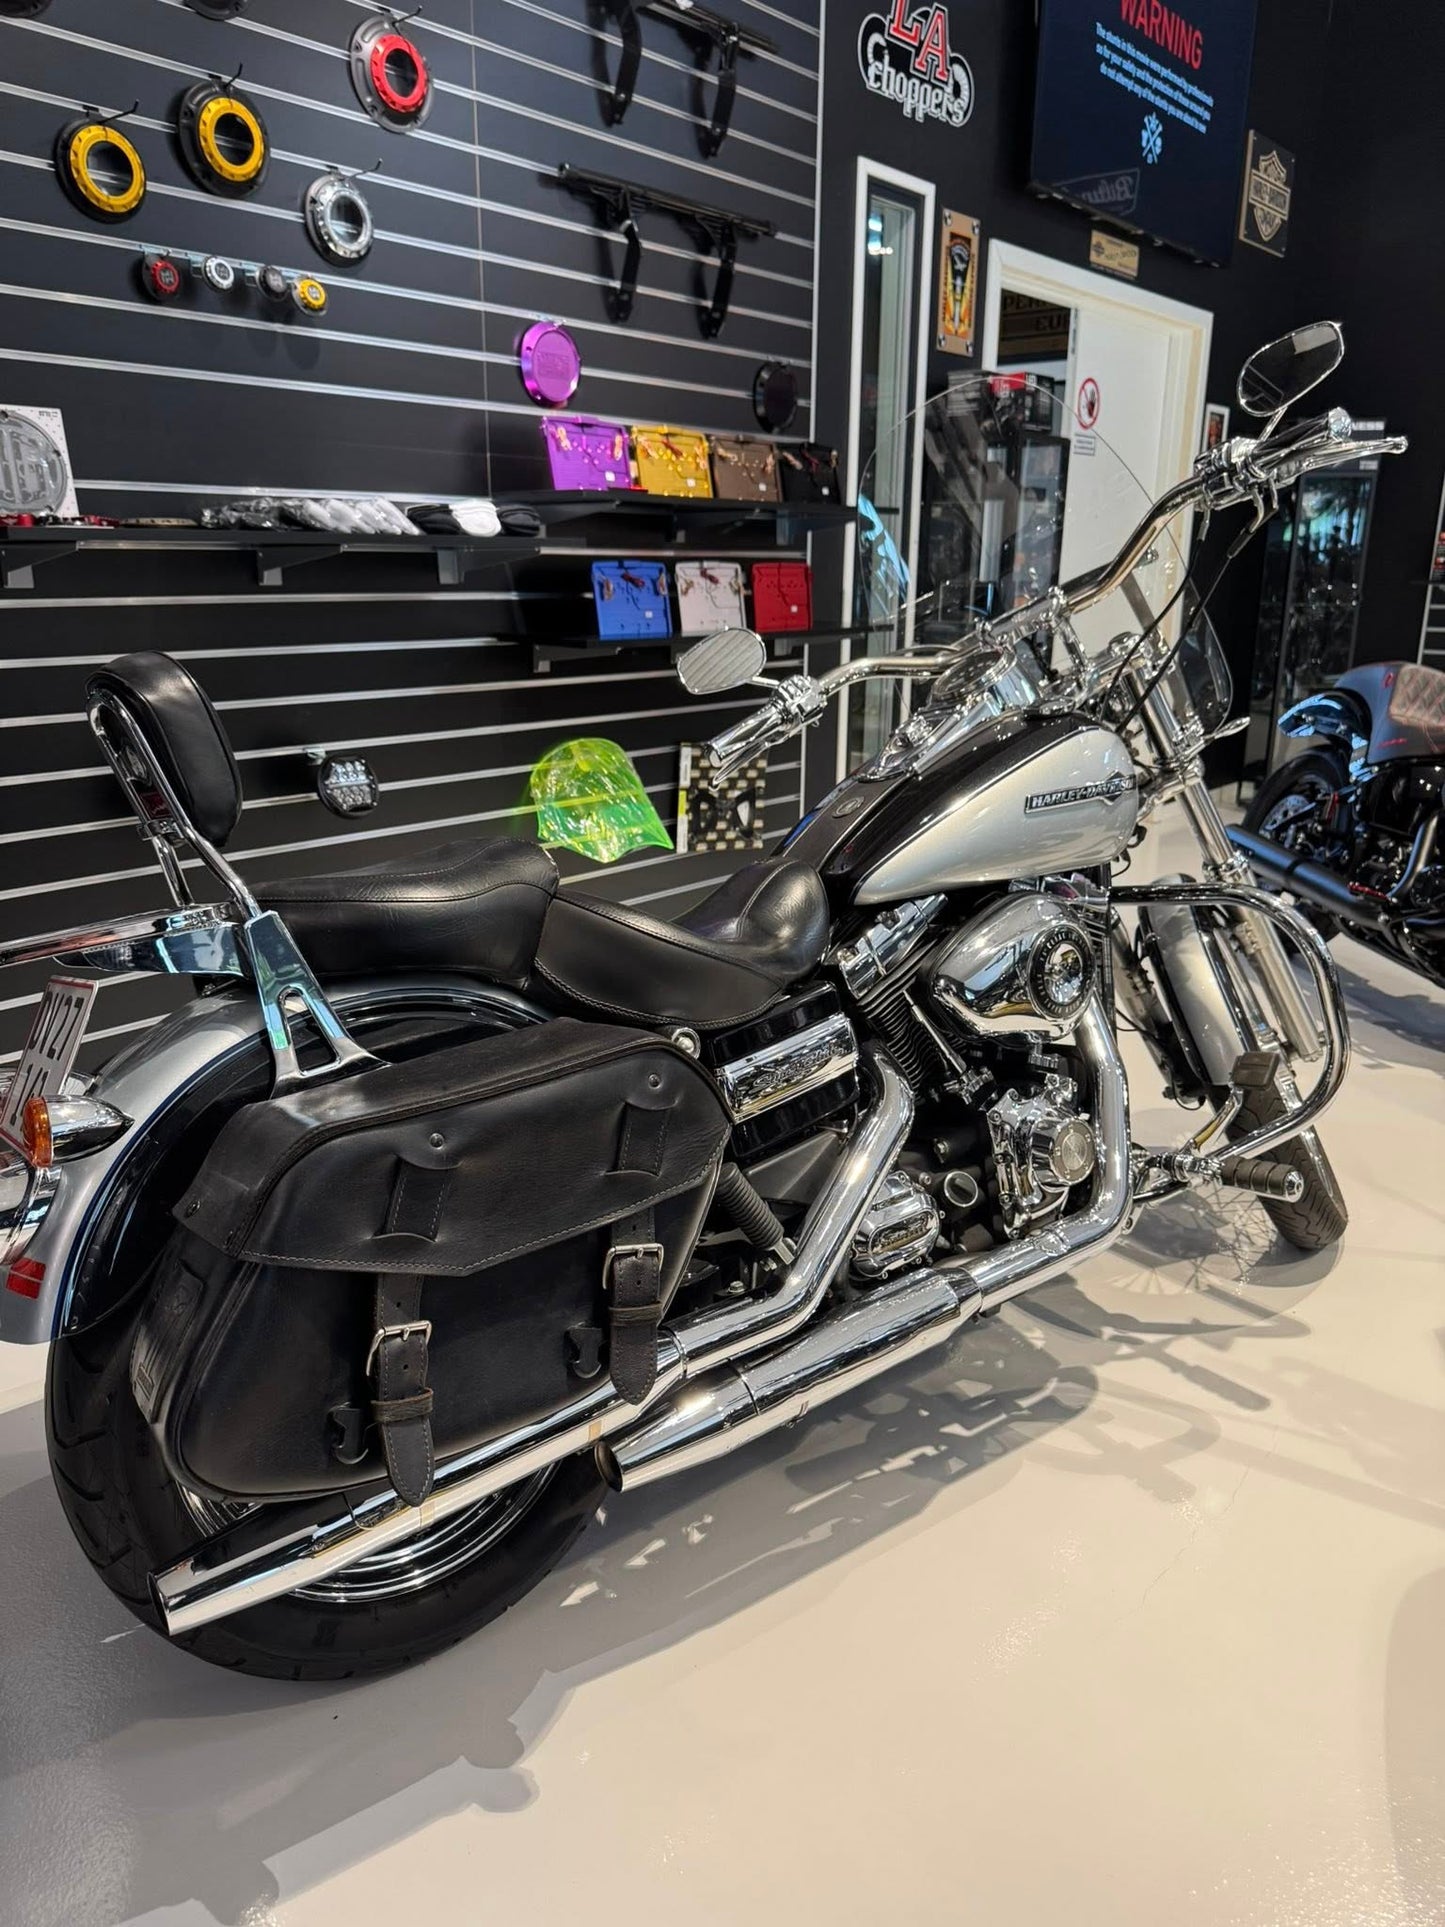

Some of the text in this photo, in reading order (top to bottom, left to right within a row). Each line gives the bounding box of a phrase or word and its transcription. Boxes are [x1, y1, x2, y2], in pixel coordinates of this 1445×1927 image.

[888, 0, 949, 82] LA
[1120, 0, 1203, 70] WARNING
[29, 991, 85, 1061] DV27
